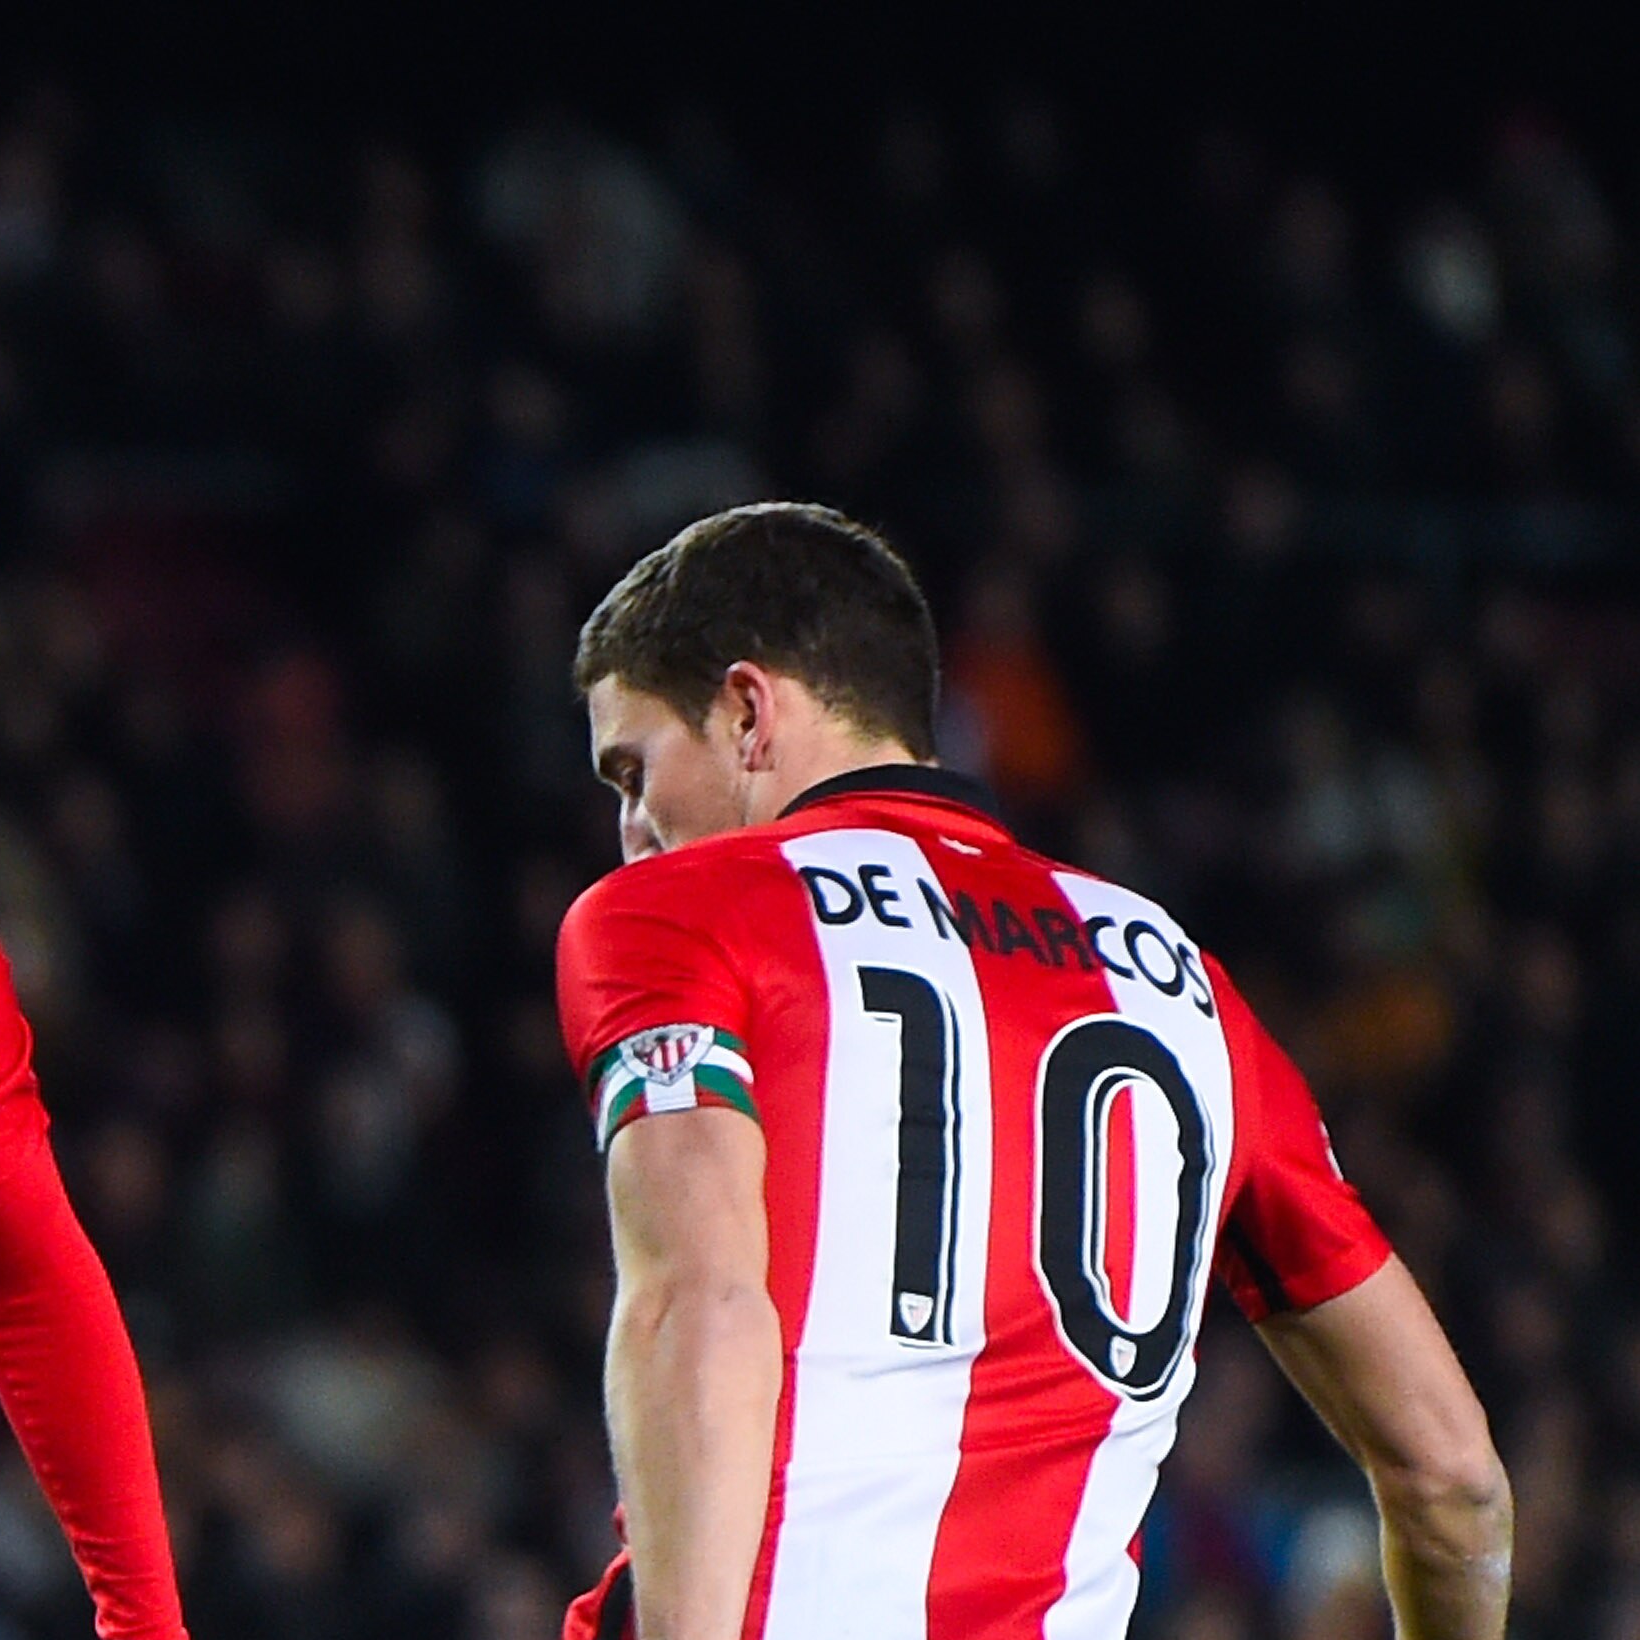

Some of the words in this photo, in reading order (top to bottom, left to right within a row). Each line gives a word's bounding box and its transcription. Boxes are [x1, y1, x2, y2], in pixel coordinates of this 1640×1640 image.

[798, 863, 913, 929] DE
[917, 877, 1216, 1019] MARCOS
[855, 963, 1216, 1402] 10
